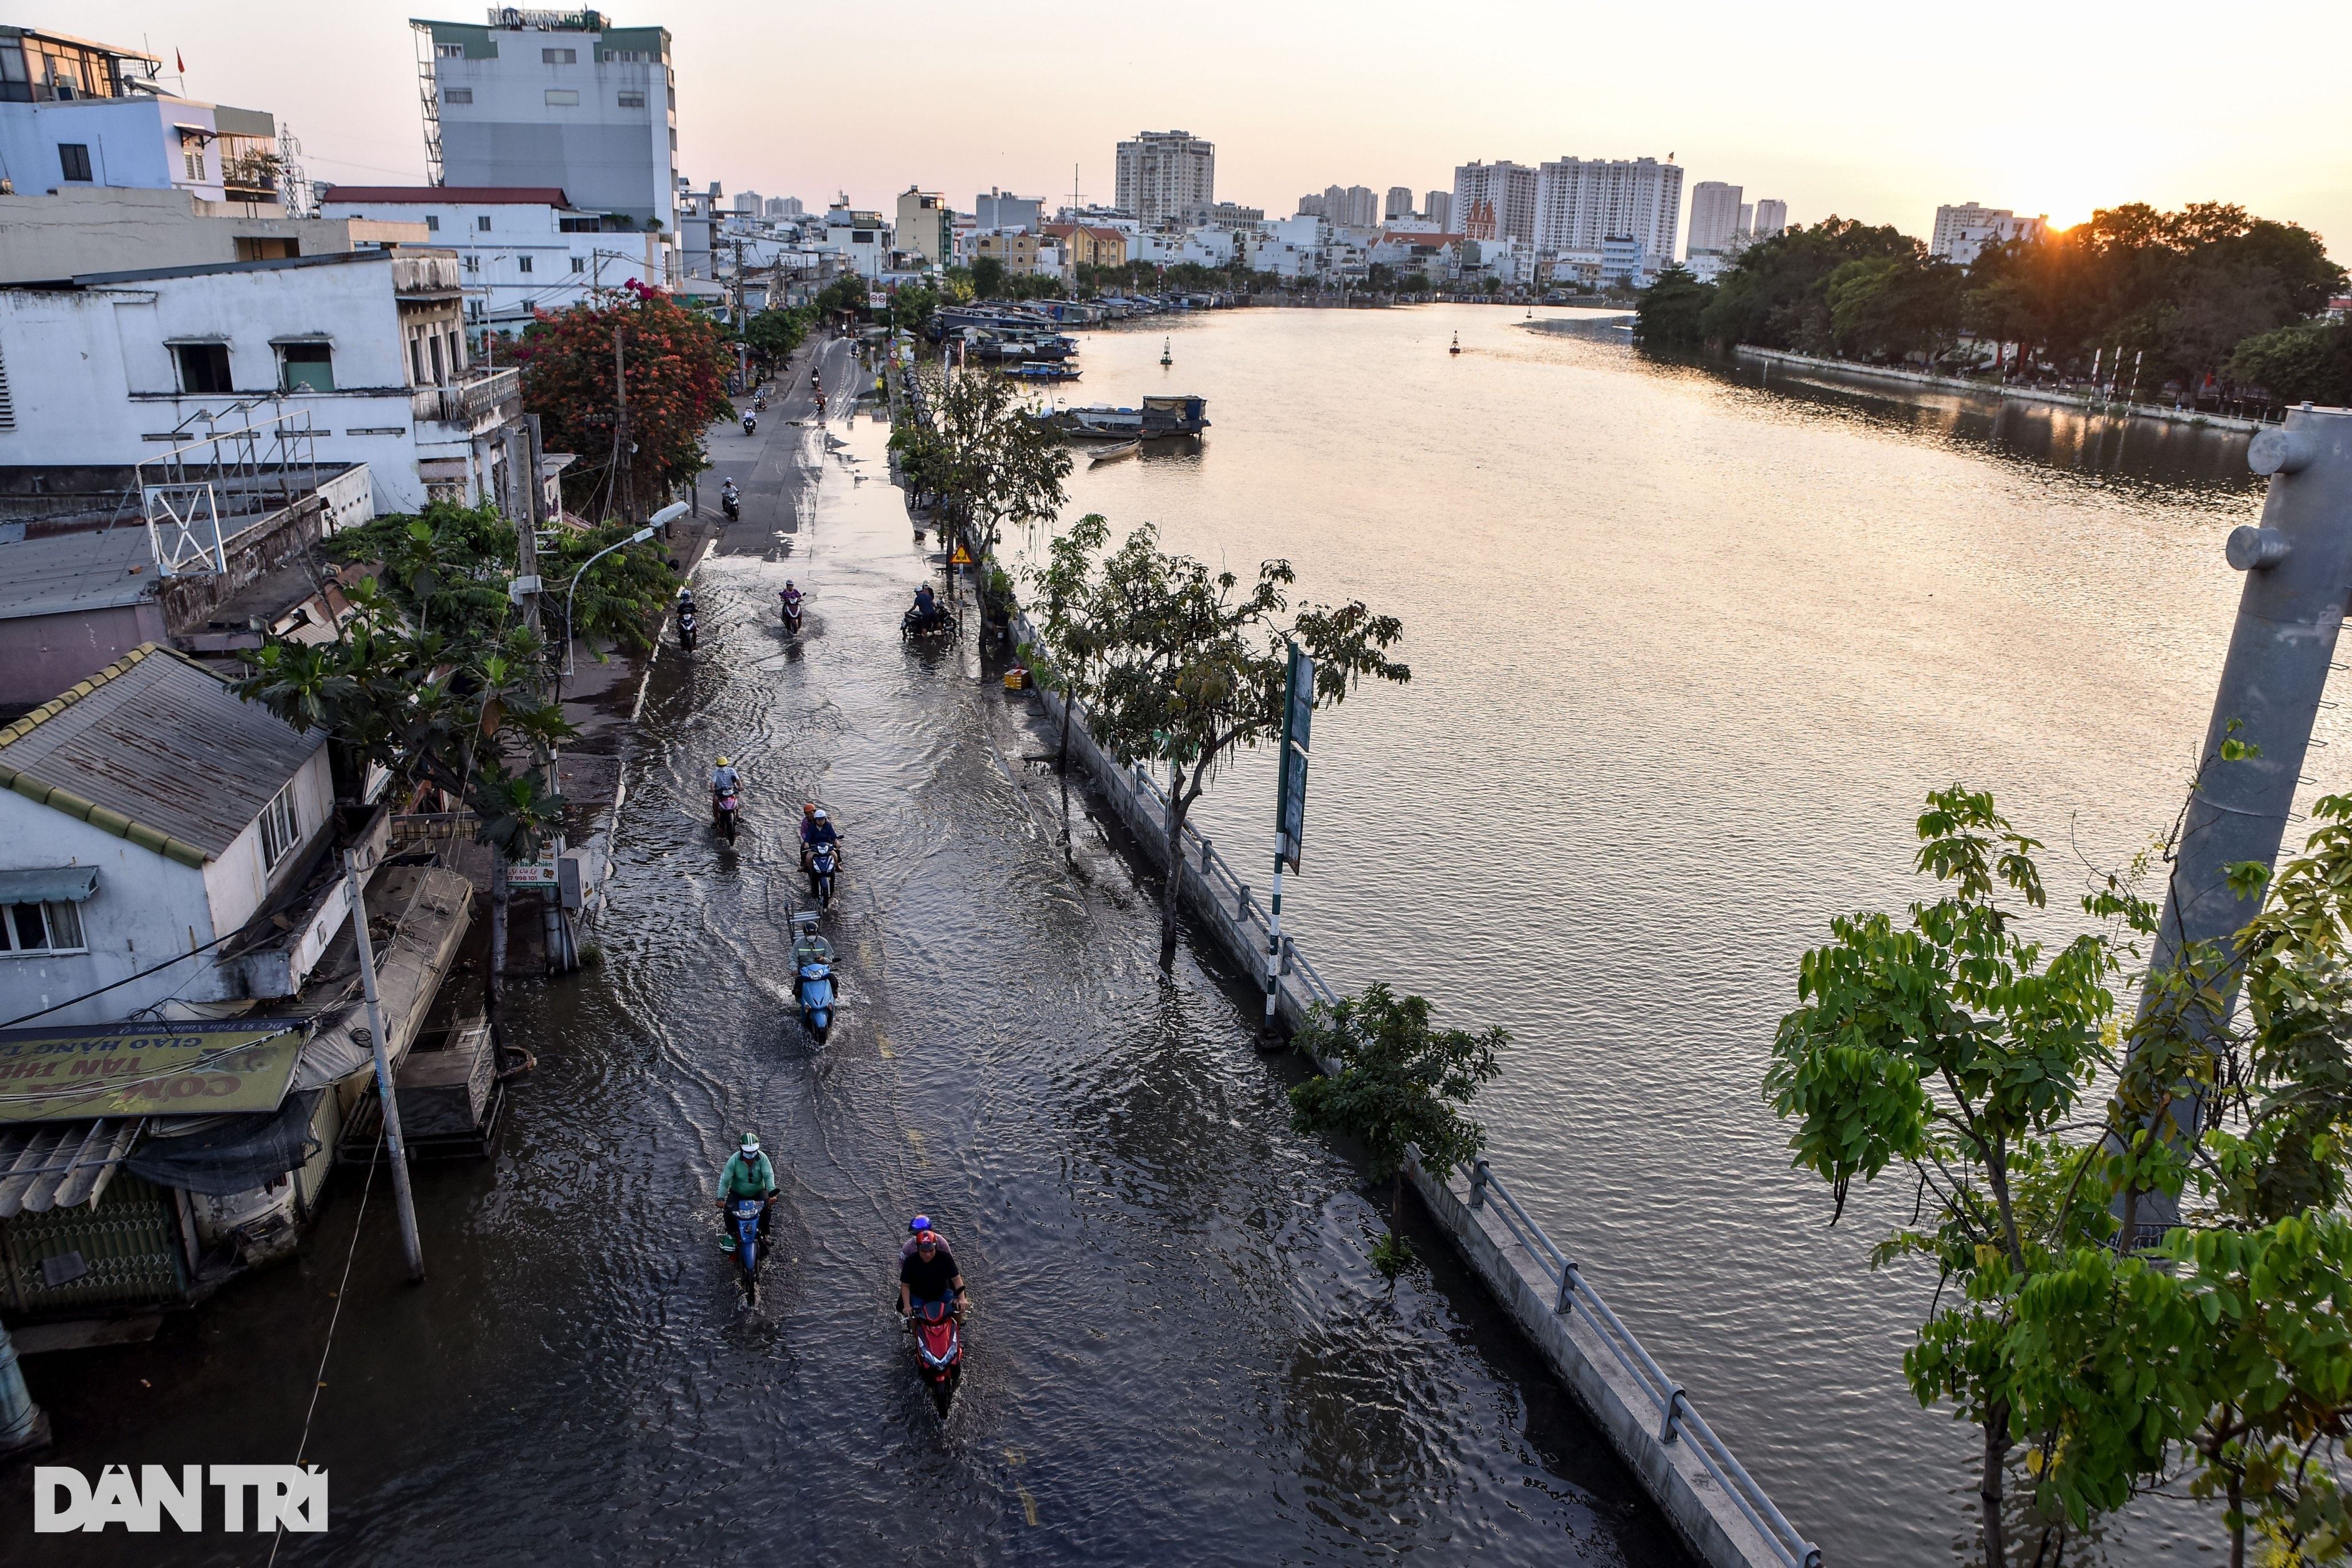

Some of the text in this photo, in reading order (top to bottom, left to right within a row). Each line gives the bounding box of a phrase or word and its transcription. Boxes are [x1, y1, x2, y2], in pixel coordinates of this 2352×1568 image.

[524, 12, 559, 28] GIANG
[565, 13, 600, 28] HOTEL
[172, 1025, 206, 1033] Xuân
[33, 1040, 123, 1055] HÀNG
[129, 1037, 202, 1050] GIAO
[117, 1076, 242, 1103] CƠM
